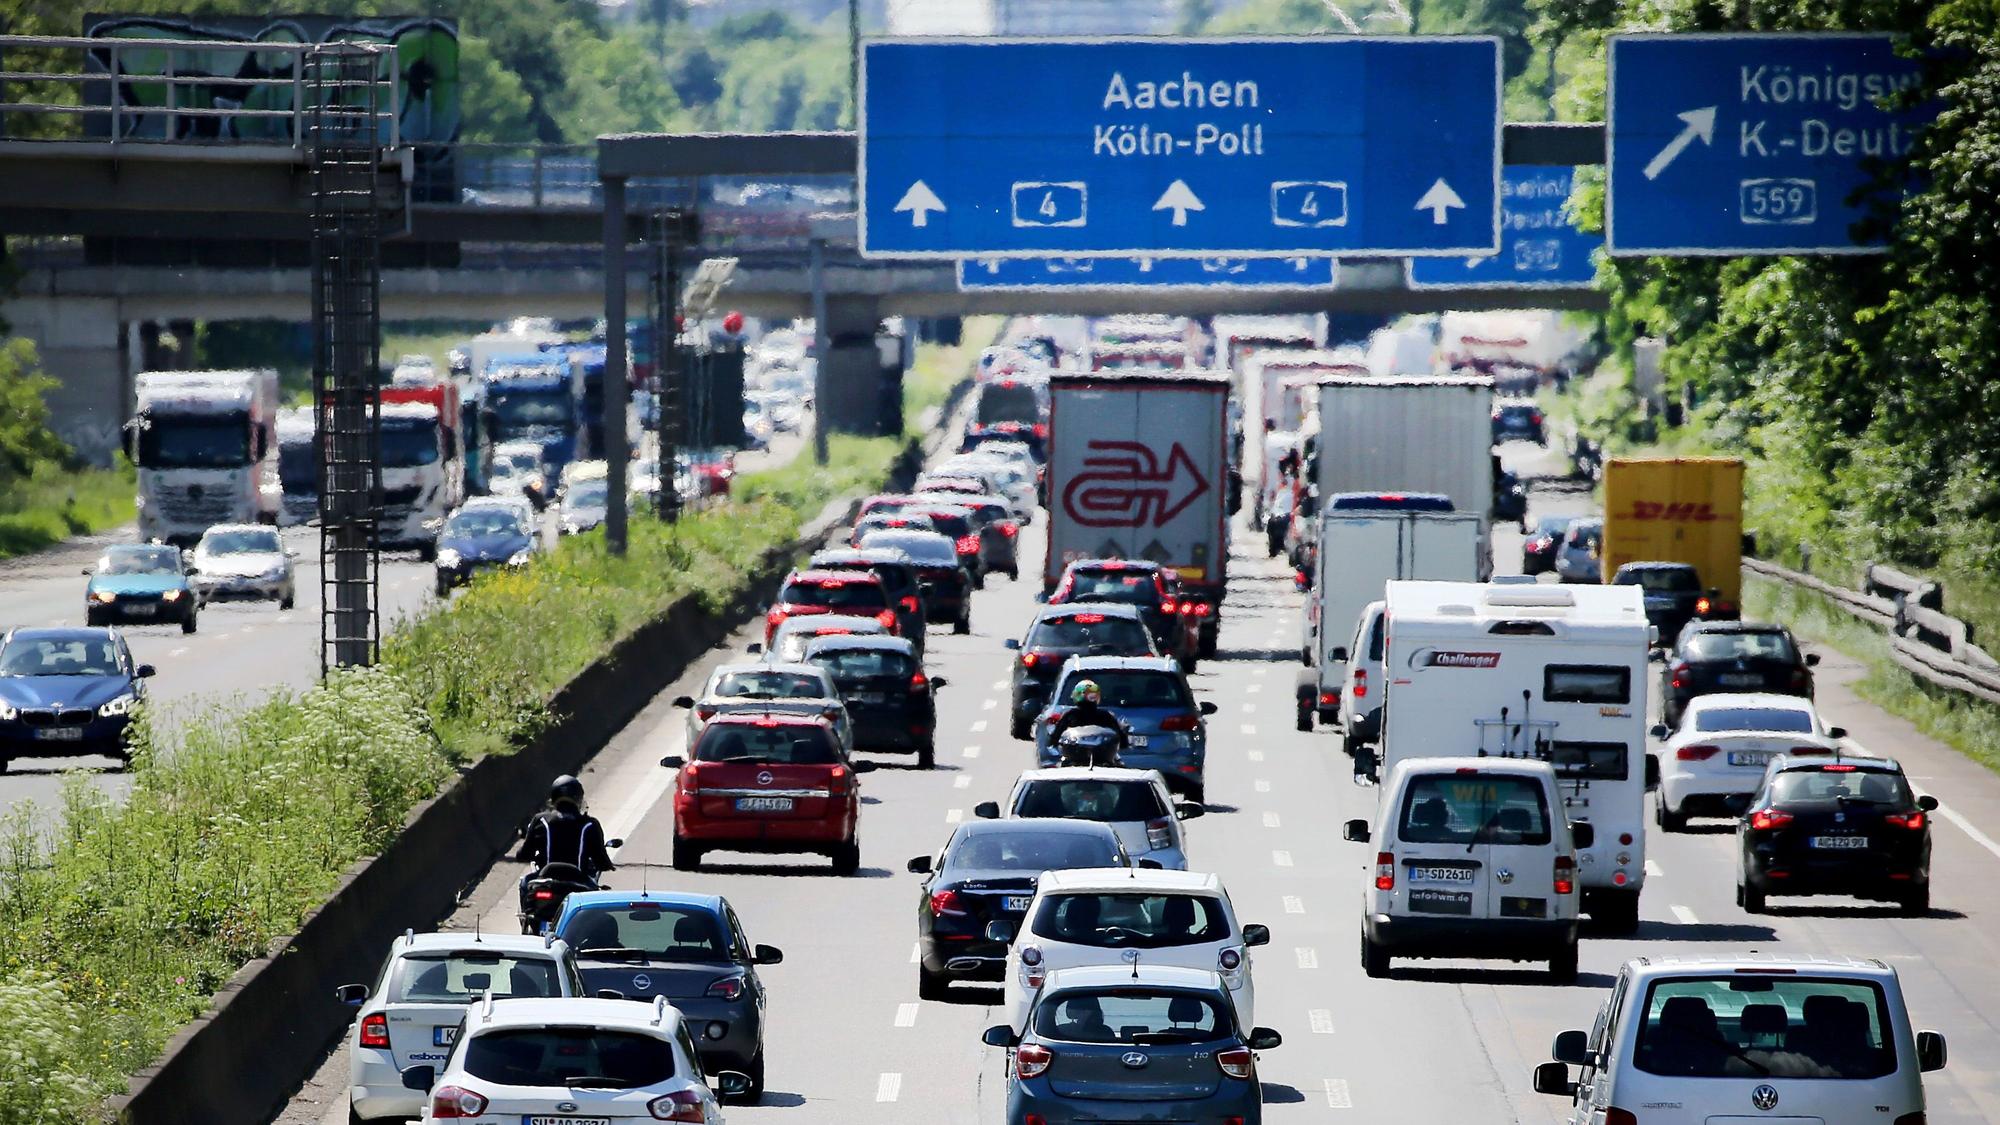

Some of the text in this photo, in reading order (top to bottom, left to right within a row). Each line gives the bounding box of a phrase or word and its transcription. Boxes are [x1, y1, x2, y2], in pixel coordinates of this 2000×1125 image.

[1103, 71, 1258, 110] Aachen
[1093, 122, 1264, 156] Köln-Poll
[1039, 190, 1318, 216] 4 4
[1751, 187, 1803, 215] 559
[1633, 501, 1718, 522] DHL
[1436, 653, 1495, 667] Challenger
[1411, 891, 1470, 903] info@wm.de
